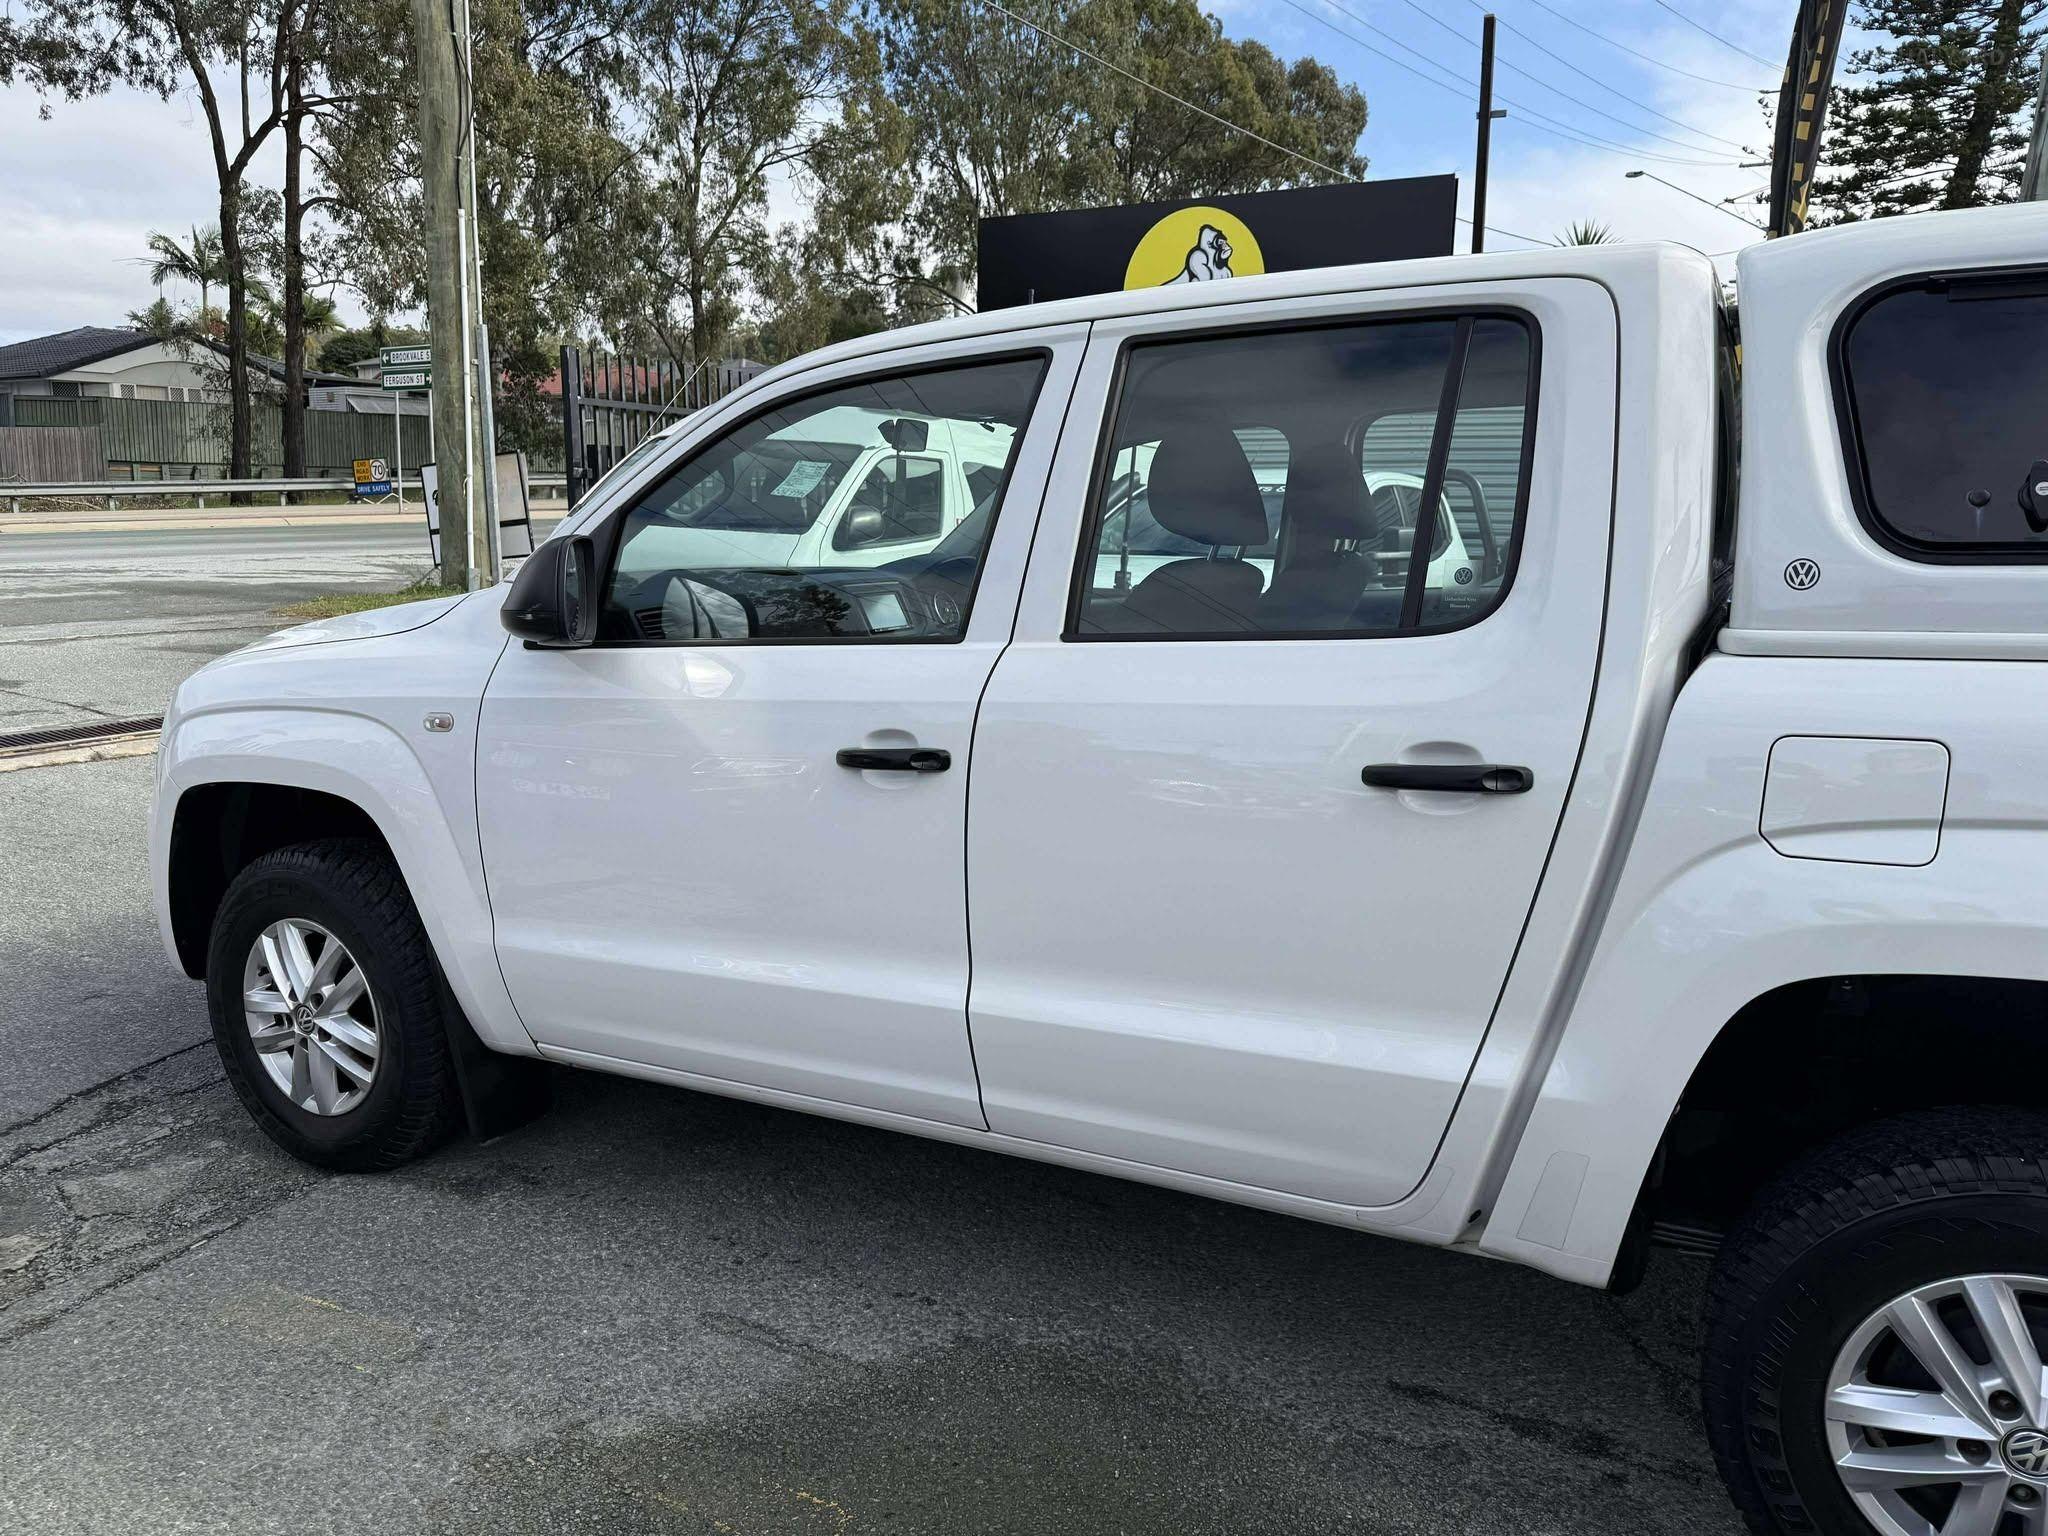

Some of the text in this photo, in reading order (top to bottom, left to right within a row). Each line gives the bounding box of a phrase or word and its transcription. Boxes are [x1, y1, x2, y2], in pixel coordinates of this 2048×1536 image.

[392, 351, 424, 363] BROOKVALE
[385, 374, 423, 385] FERGUSON ST
[372, 464, 383, 476] 70
[357, 484, 390, 493] DRIVE SAFELY
